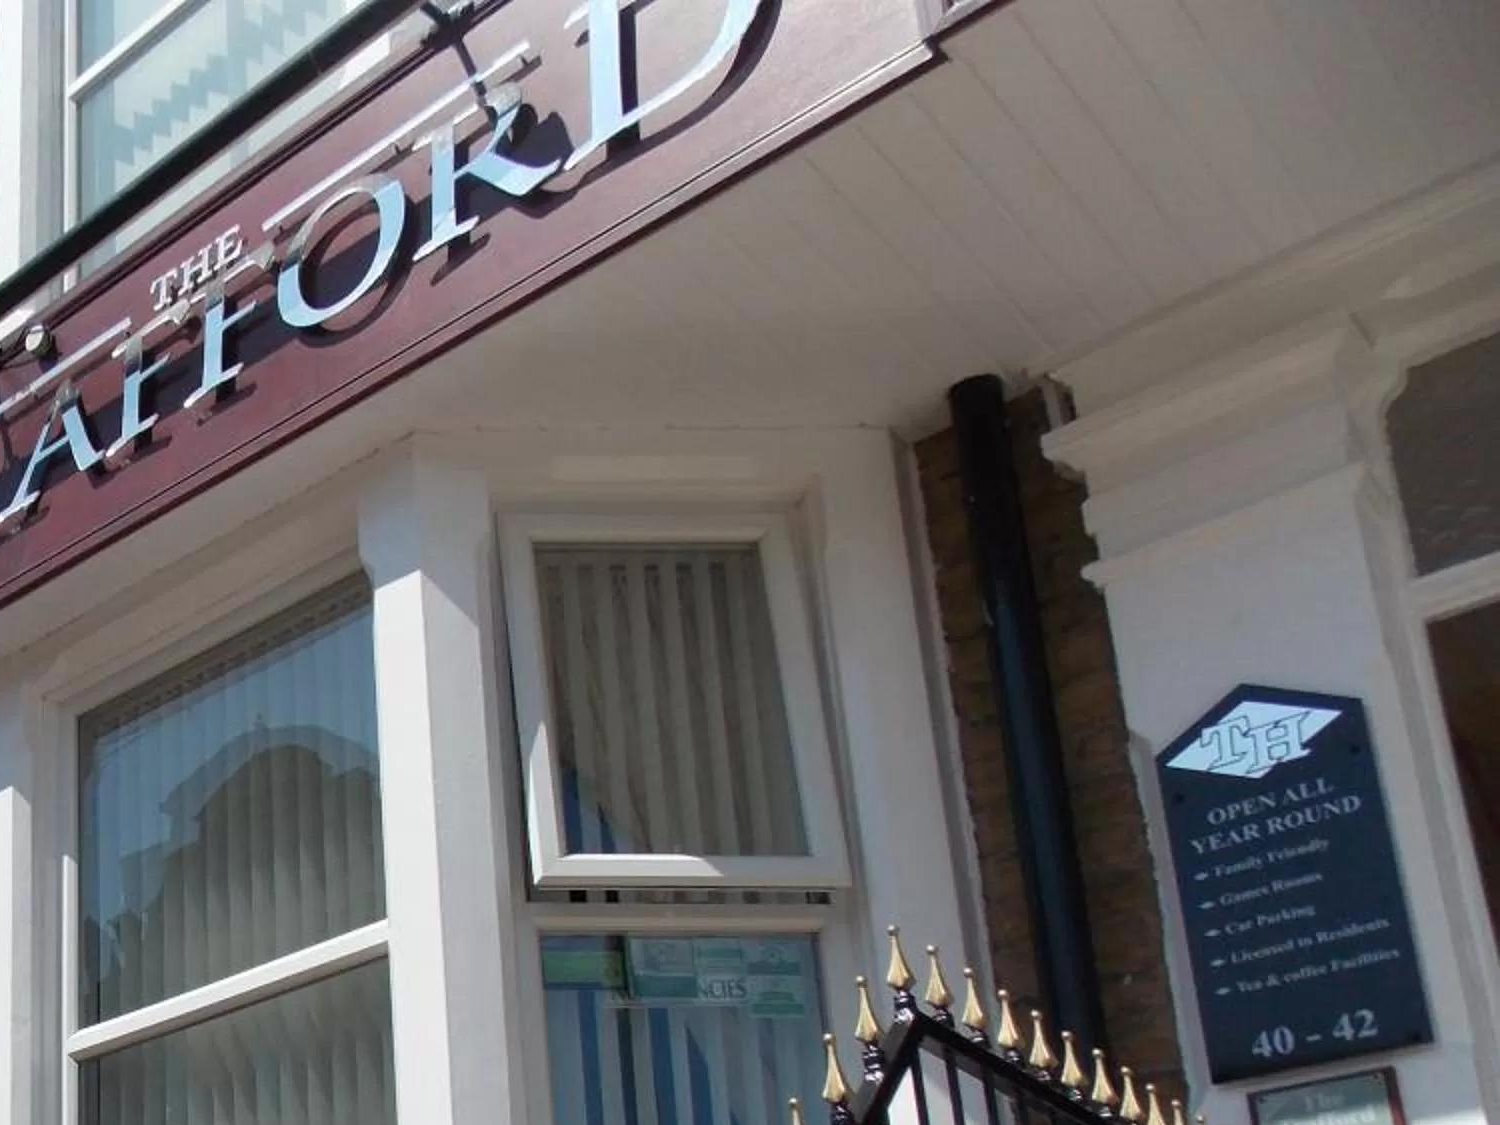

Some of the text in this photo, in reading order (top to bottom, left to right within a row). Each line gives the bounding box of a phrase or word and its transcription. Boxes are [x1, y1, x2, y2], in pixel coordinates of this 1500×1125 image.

[150, 223, 243, 311] THE
[1206, 777, 1334, 825] OPEN ALL
[1190, 795, 1361, 855] YEAR ROUND
[1213, 838, 1330, 877] Family Friendly
[1219, 886, 1269, 906] Games
[1224, 905, 1317, 935] Car Parking
[1231, 940, 1295, 964] Licensed
[1316, 918, 1391, 943] Residents
[1236, 979, 1263, 993] Tea
[1252, 1024, 1296, 1058] 40
[1332, 1008, 1378, 1041] 42
